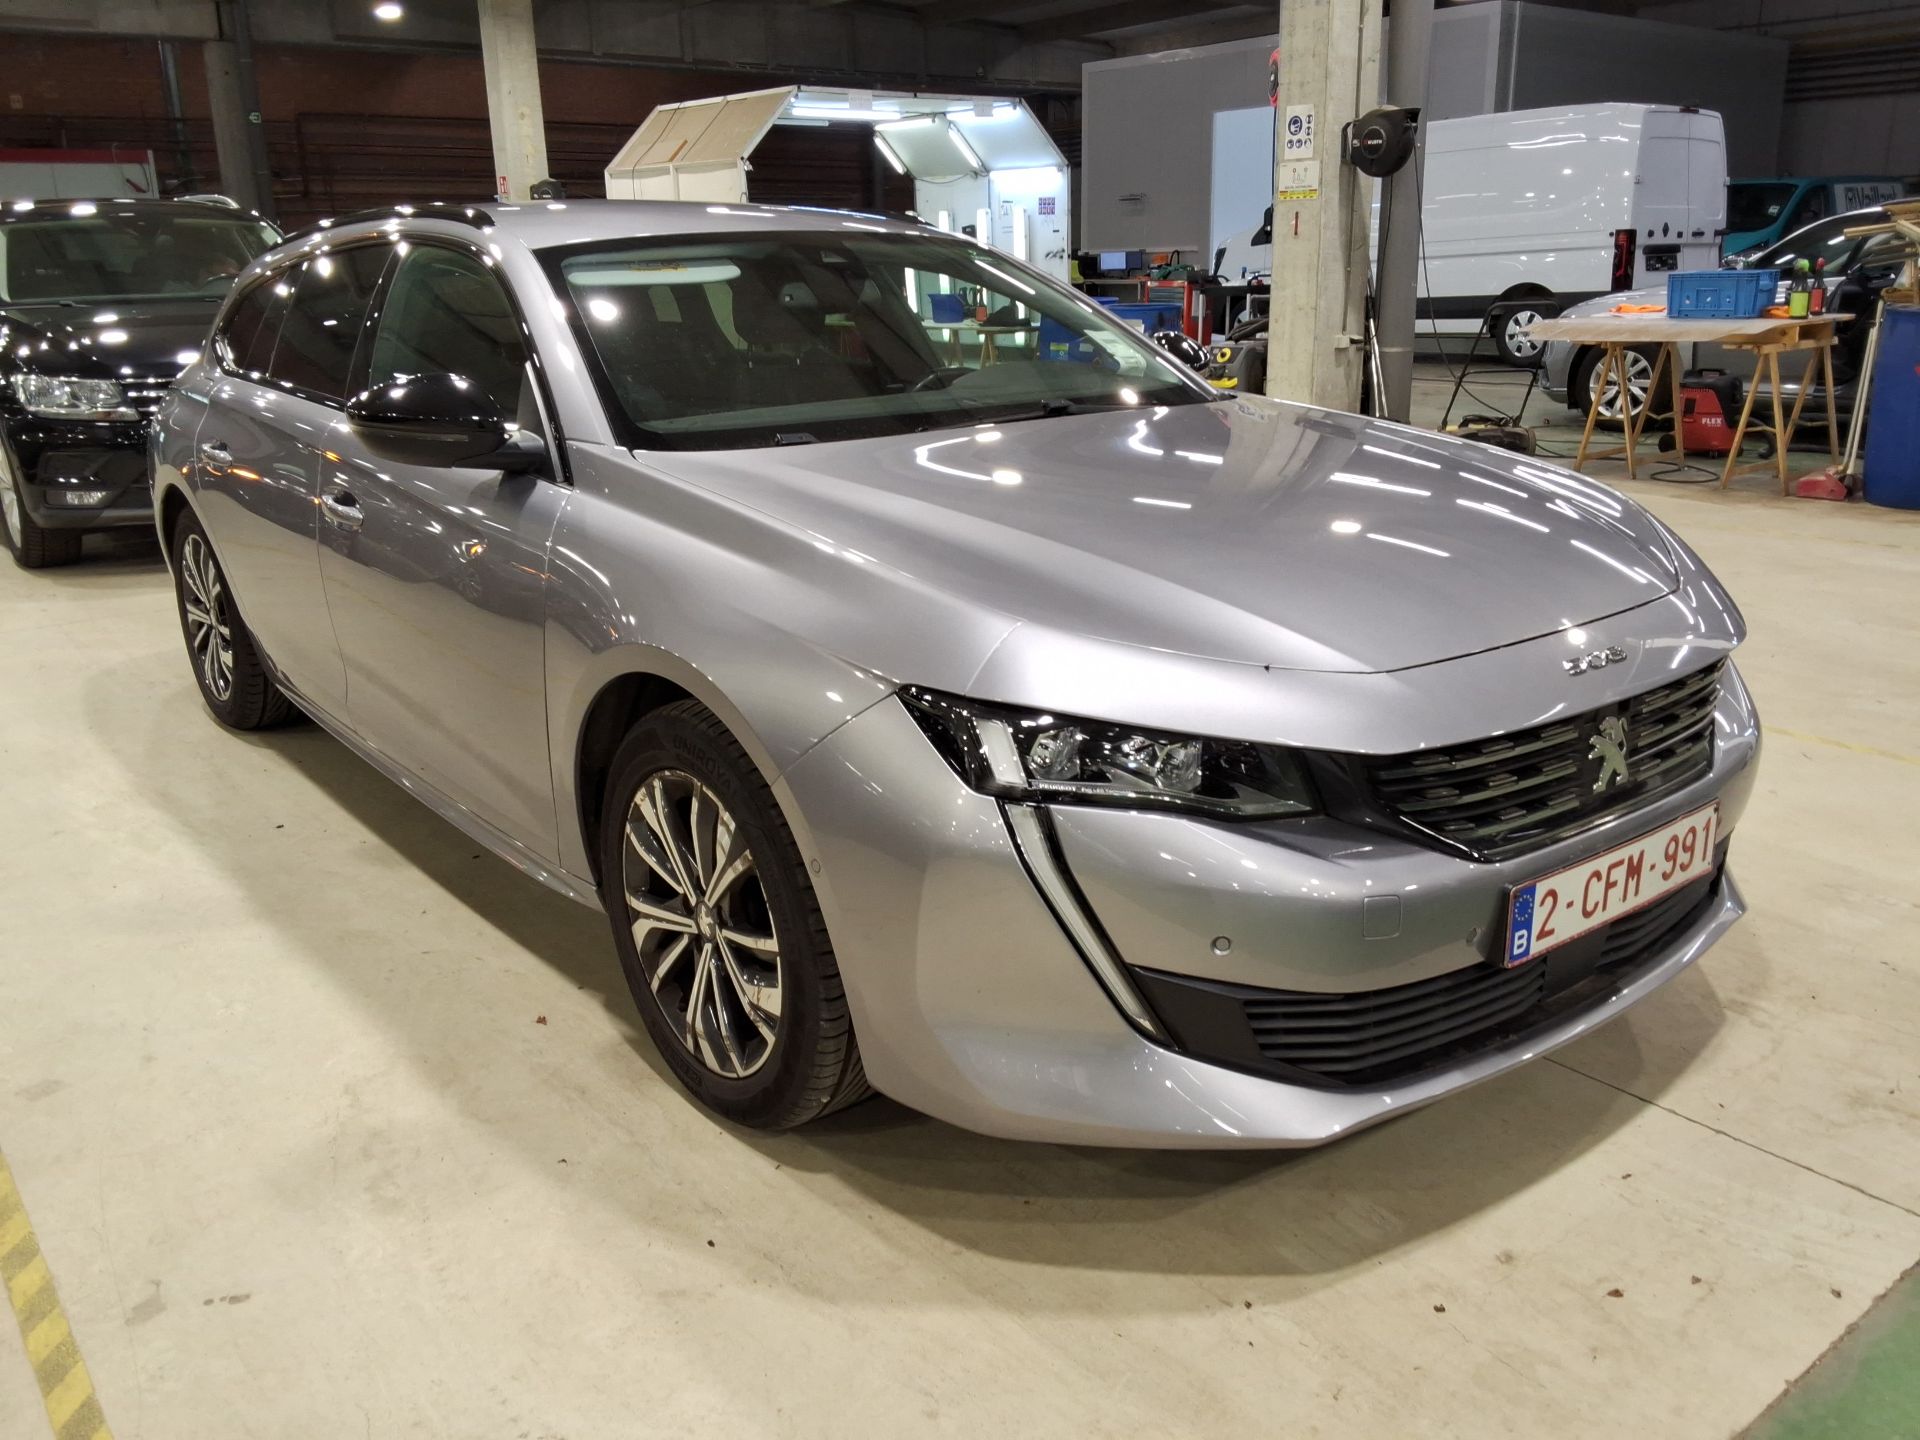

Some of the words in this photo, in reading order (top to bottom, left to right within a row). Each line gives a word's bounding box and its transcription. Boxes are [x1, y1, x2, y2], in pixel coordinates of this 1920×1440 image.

[1702, 417, 1722, 425] FLEX
[1562, 645, 1628, 677] 508
[672, 733, 738, 800] UNIROYA
[1535, 816, 1712, 943] 2-CFM-991
[1513, 928, 1528, 956] B
